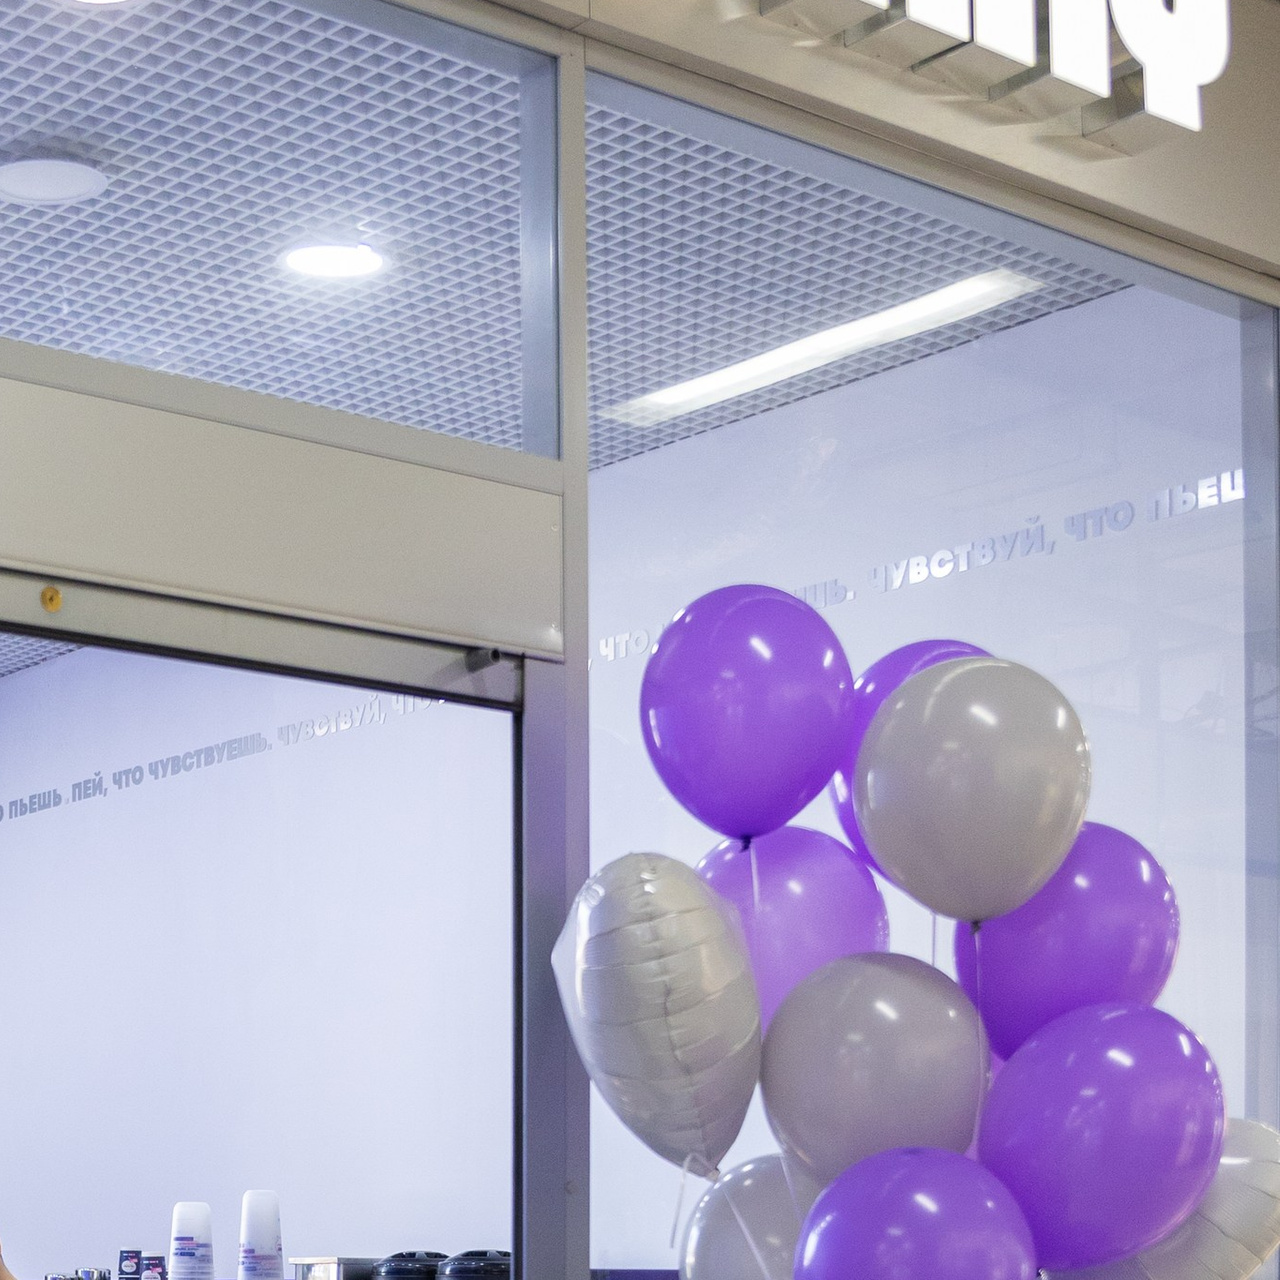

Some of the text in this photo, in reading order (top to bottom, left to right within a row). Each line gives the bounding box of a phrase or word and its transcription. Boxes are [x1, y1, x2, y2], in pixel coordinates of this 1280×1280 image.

[599, 629, 650, 662] ЧТО
[869, 515, 1056, 594] ЧУВСТВУЙ,
[1064, 500, 1136, 542] ЧТО
[71, 771, 109, 803] ПЕЙ,
[112, 765, 145, 790] ЧТО
[148, 732, 273, 781] ЧУВСТВУЕШЬ.
[277, 694, 387, 746] ЧУВСТВУЙ,
